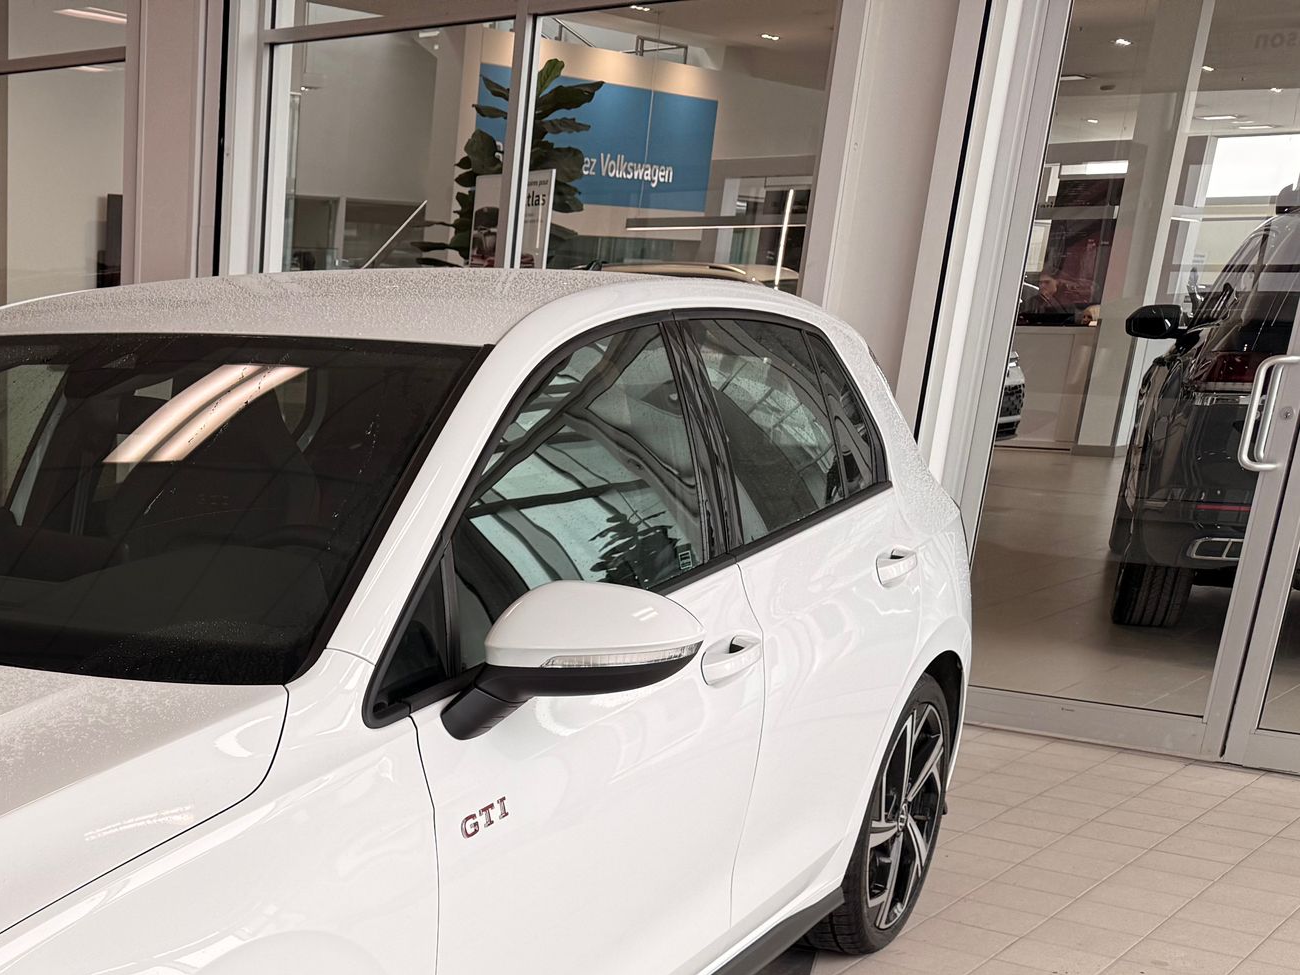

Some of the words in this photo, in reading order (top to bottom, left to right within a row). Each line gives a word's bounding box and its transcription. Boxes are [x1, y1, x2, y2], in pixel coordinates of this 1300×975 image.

[582, 156, 597, 176] ez
[600, 152, 674, 188] Volkswagen
[527, 190, 546, 207] tlas
[460, 796, 509, 839] GTI
